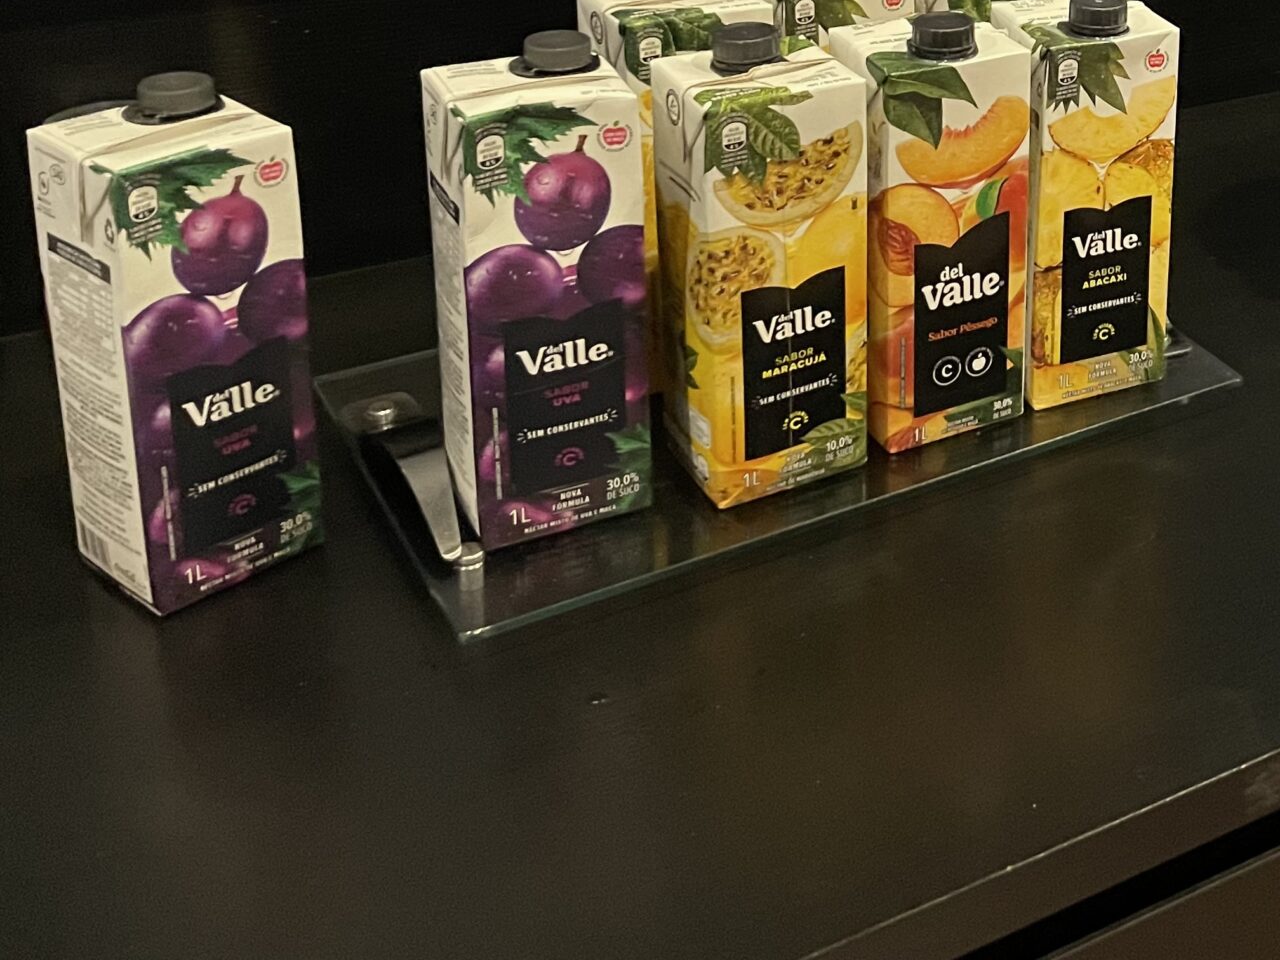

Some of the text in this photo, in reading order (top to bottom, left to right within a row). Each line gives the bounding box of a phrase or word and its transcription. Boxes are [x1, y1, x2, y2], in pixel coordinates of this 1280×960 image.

[1071, 227, 1139, 258] Valle
[1092, 230, 1105, 240] del
[940, 262, 964, 281] del
[1082, 272, 1127, 289] ABACAXI
[1088, 265, 1121, 279] SABOR
[1073, 295, 1135, 315] SEM CONSERVANTES
[752, 305, 832, 343] Valle
[778, 311, 794, 323] del
[927, 328, 958, 341] Sabor
[515, 338, 609, 375] Valle
[546, 343, 564, 354] del
[775, 347, 814, 365] SABOR
[762, 351, 827, 379] MARACUJÁ
[543, 381, 590, 399] SABOR
[759, 377, 830, 406] SEM CONSERVANTES
[181, 381, 275, 427] Valle
[552, 393, 582, 406] UVA
[526, 412, 609, 440] SEM CONSERVANTES
[197, 480, 216, 493] SEM
[743, 471, 760, 487] 1L
[560, 488, 582, 500] NOVA
[606, 482, 640, 501] DE SUCO
[509, 507, 532, 526] 1L
[184, 564, 207, 584] 1L
